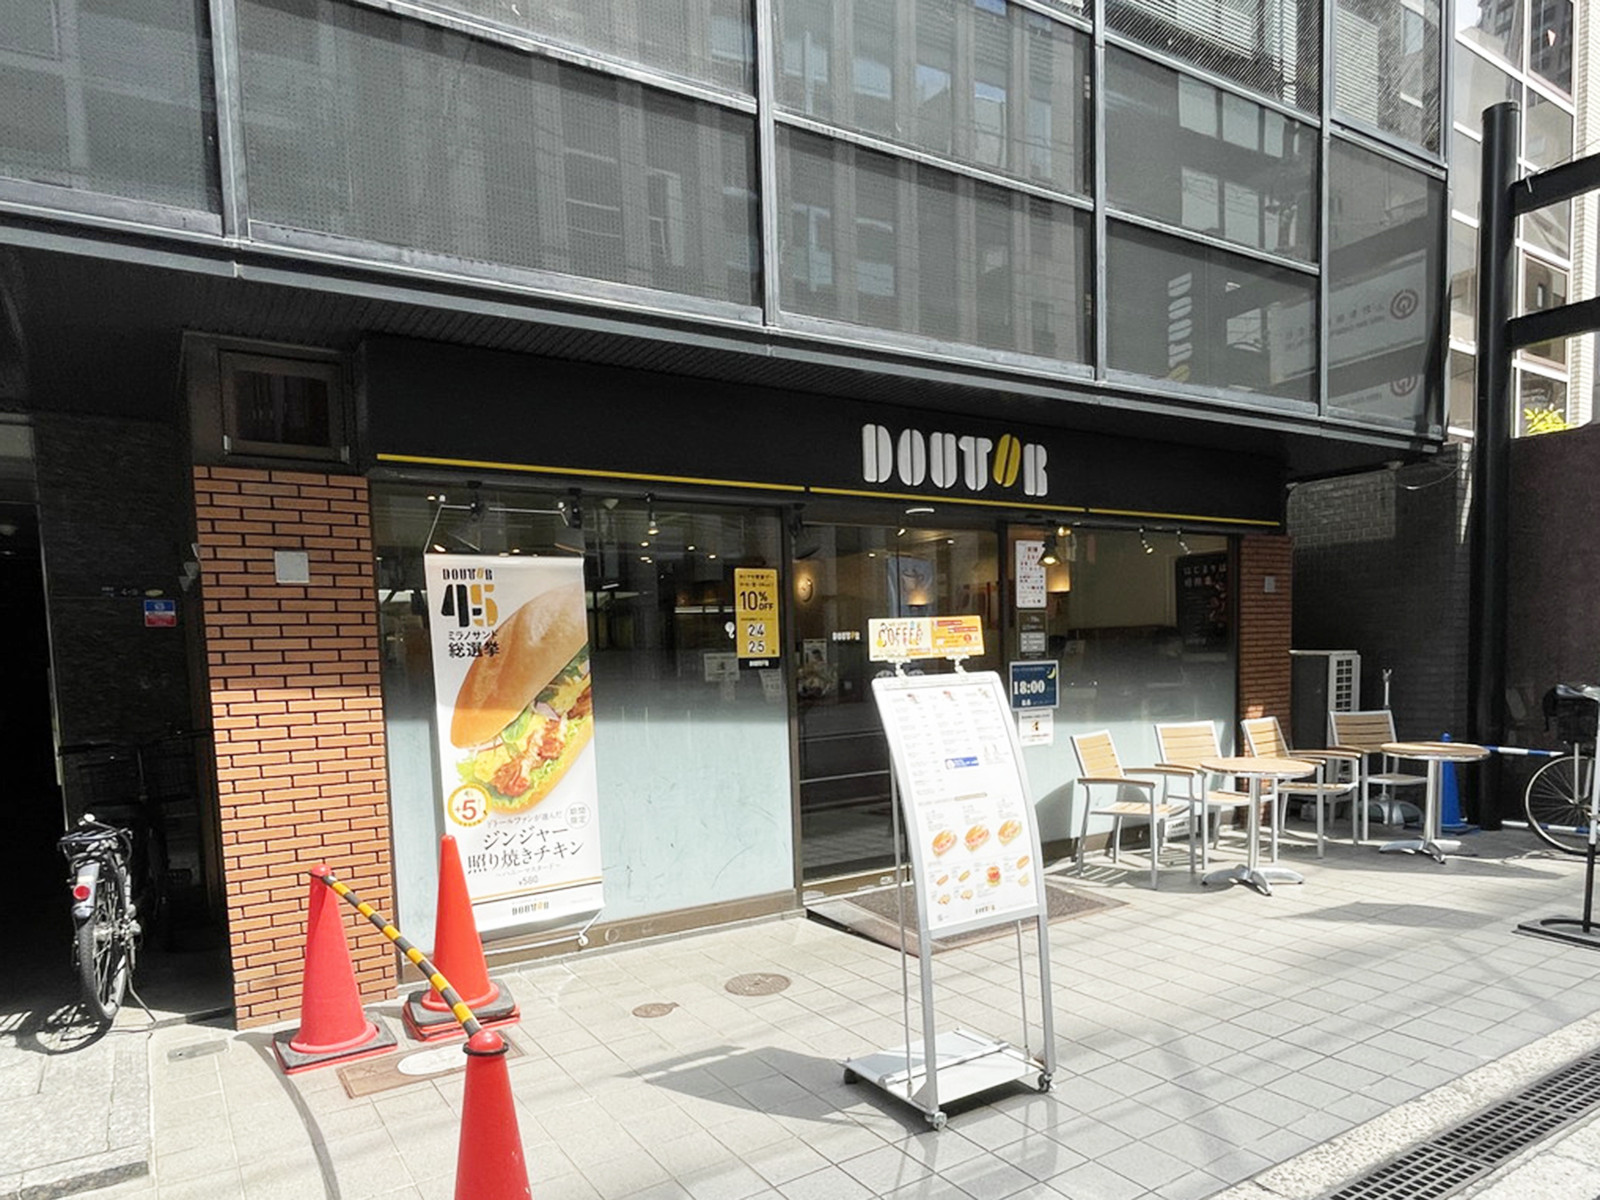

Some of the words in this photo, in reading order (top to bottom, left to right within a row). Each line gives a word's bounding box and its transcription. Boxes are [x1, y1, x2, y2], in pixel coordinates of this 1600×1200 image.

[861, 423, 1048, 497] DOUTOR
[442, 567, 493, 580] DOUTOR
[441, 583, 499, 628] 45
[759, 602, 774, 611] OFF
[448, 629, 499, 641] ミラノサンド
[748, 624, 764, 637] 24
[448, 641, 500, 659] 総選挙
[748, 640, 765, 653] 25
[1013, 679, 1045, 695] 18:00
[483, 825, 568, 851] ジンジャー
[467, 841, 584, 875] 照り焼きチキン
